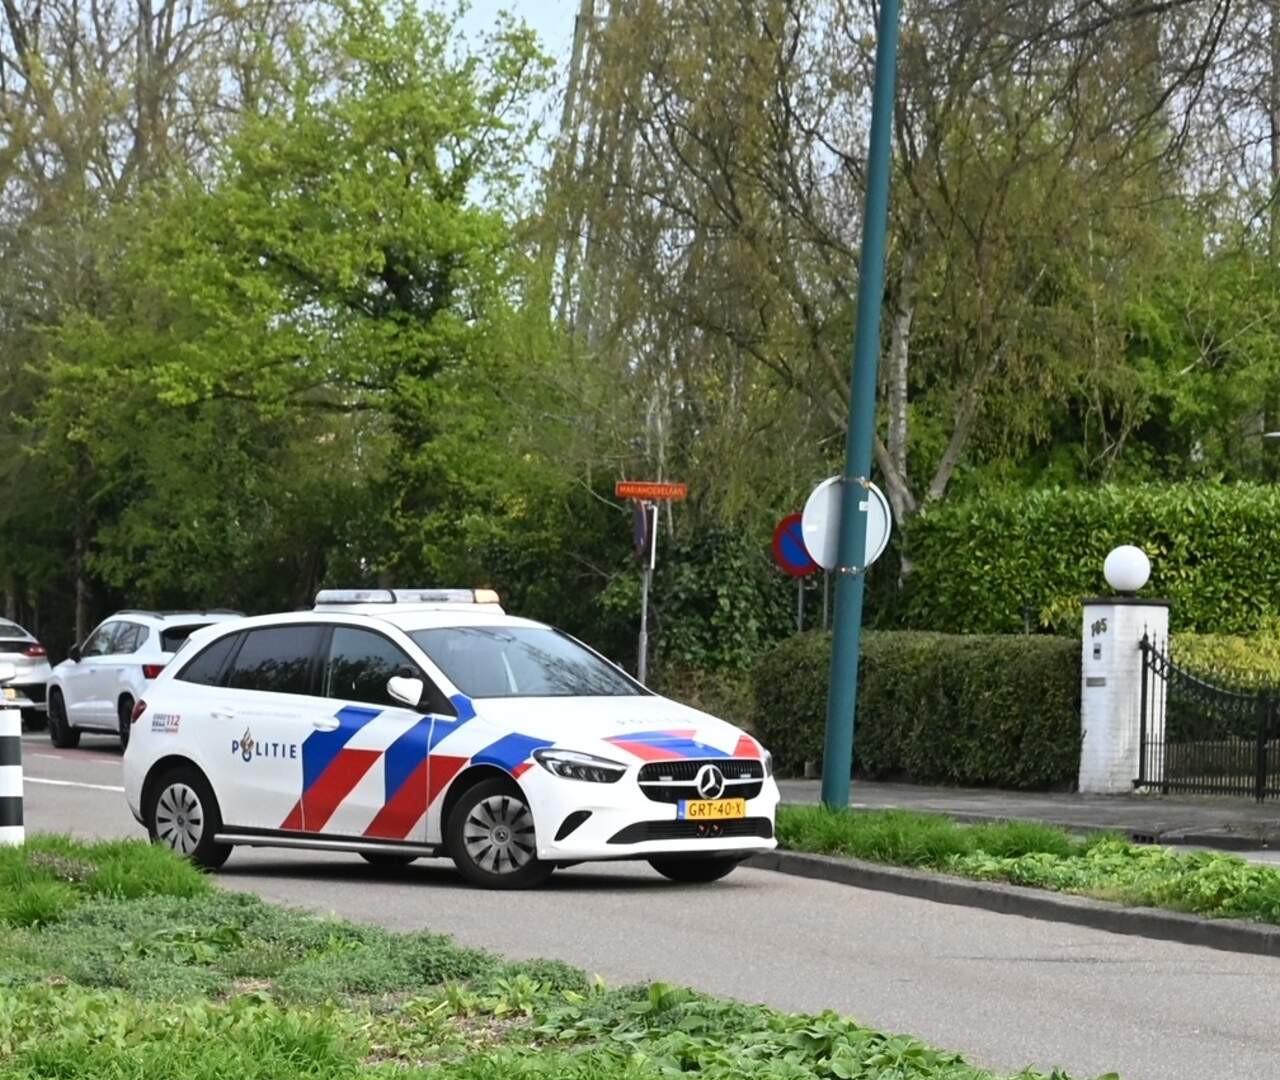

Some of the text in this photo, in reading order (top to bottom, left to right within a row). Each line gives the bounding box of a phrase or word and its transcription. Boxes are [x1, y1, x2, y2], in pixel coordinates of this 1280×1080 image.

[166, 714, 181, 726] 112
[232, 739, 297, 762] POLITIE
[688, 802, 741, 816] GRT-40-X
